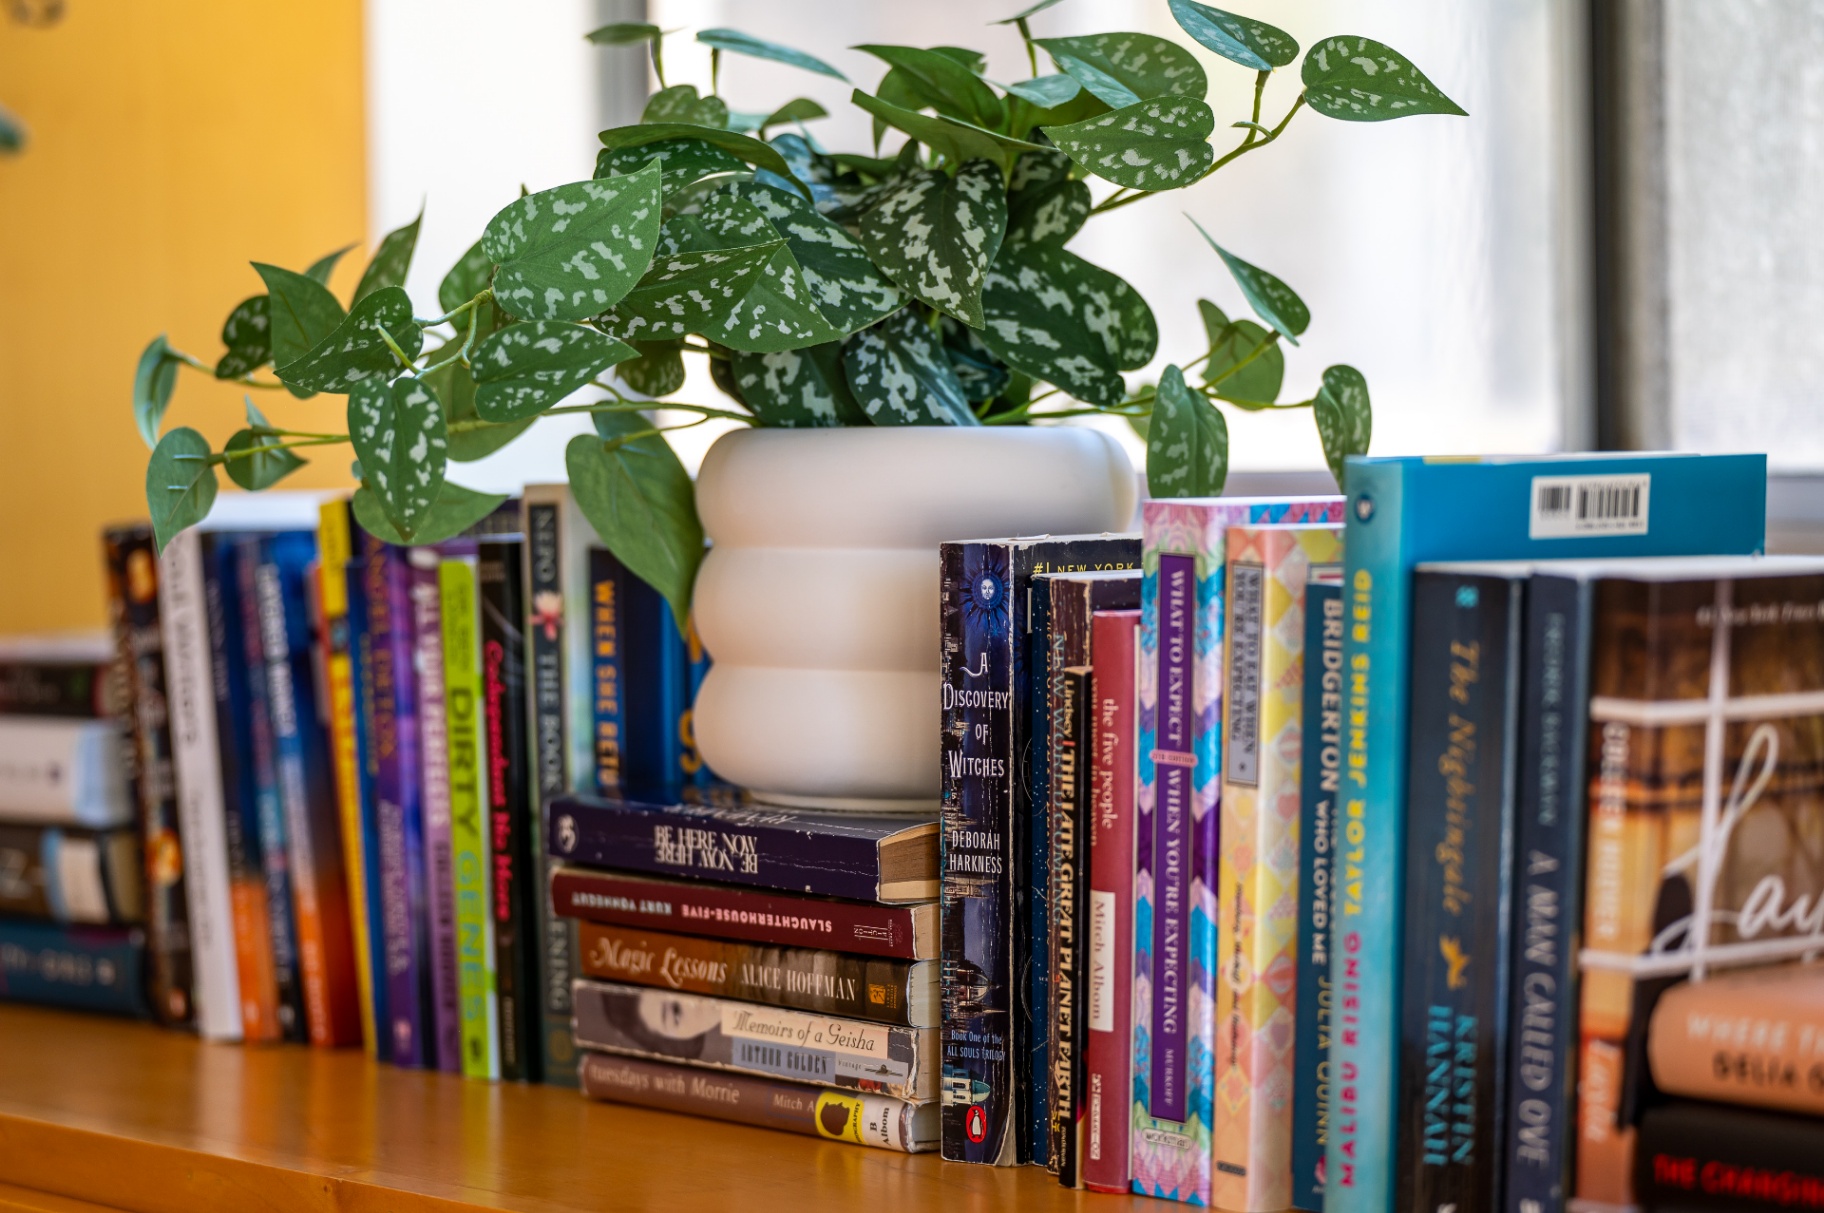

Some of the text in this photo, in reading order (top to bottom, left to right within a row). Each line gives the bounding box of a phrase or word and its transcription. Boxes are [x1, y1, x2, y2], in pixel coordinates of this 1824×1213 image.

[595, 580, 621, 787] WHEN SHE RETU
[960, 652, 989, 677] A
[1053, 634, 1065, 697] NEW
[1167, 570, 1185, 746] WHAT TO EXPECT
[943, 682, 1010, 711] DISCOVERY
[1063, 680, 1075, 737] Lindsey
[1320, 598, 1345, 791] BRIDGERTON
[484, 642, 511, 806] Codependent
[975, 723, 989, 746] OF
[1343, 570, 1373, 917] TAYLOR JENKINS REID
[450, 687, 480, 842] DIRTY
[538, 724, 563, 793] BOOK
[948, 750, 1005, 778] WITCHES
[1053, 708, 1065, 806] WORLD
[1061, 750, 1075, 799] THE
[1099, 698, 1120, 829] the five people
[1436, 640, 1480, 915] The Nightingale
[1167, 769, 1181, 833] WHEN
[654, 825, 758, 856] BE HERE NOW
[654, 843, 759, 875] BE NOW HERE
[949, 853, 1003, 874] HARKNESS
[952, 830, 1000, 849] DEBORAH
[494, 853, 514, 922] More
[639, 898, 673, 916] KURT
[1311, 800, 1330, 965] WHO LOVED ME
[456, 851, 484, 1022] GENES
[681, 904, 832, 933] SLAUGHTERHOUSE-FIVE
[853, 927, 887, 938] FICTION
[546, 918, 572, 1010] ENING
[589, 937, 727, 988] Magic Lessons
[740, 962, 782, 989] ALICE
[786, 969, 856, 1001] HOFFMAN
[1092, 900, 1107, 1020] Mitch Albom
[1162, 918, 1179, 1034] EXPECTING
[733, 1010, 875, 1052] Memoirs of a Geisha
[951, 1029, 967, 1041] Book
[969, 1032, 982, 1043] One
[1316, 975, 1333, 1049] JULIA
[1517, 849, 1560, 1167] A MAN CALLED OVE
[741, 1043, 827, 1075] ARTHUR GOLDEN
[947, 1045, 1006, 1061] ALL SOULS TRILOGY
[1337, 931, 1362, 1187] MALIBU RISING
[1711, 1050, 1799, 1089] DELIA
[655, 1072, 686, 1094] with
[692, 1080, 741, 1105] Morrie
[773, 1093, 815, 1112] Mitch A
[1423, 1004, 1454, 1166] HANNAH
[1452, 1014, 1479, 1165] KRISTIN
[869, 1121, 878, 1132] B
[881, 1107, 892, 1146] Albom
